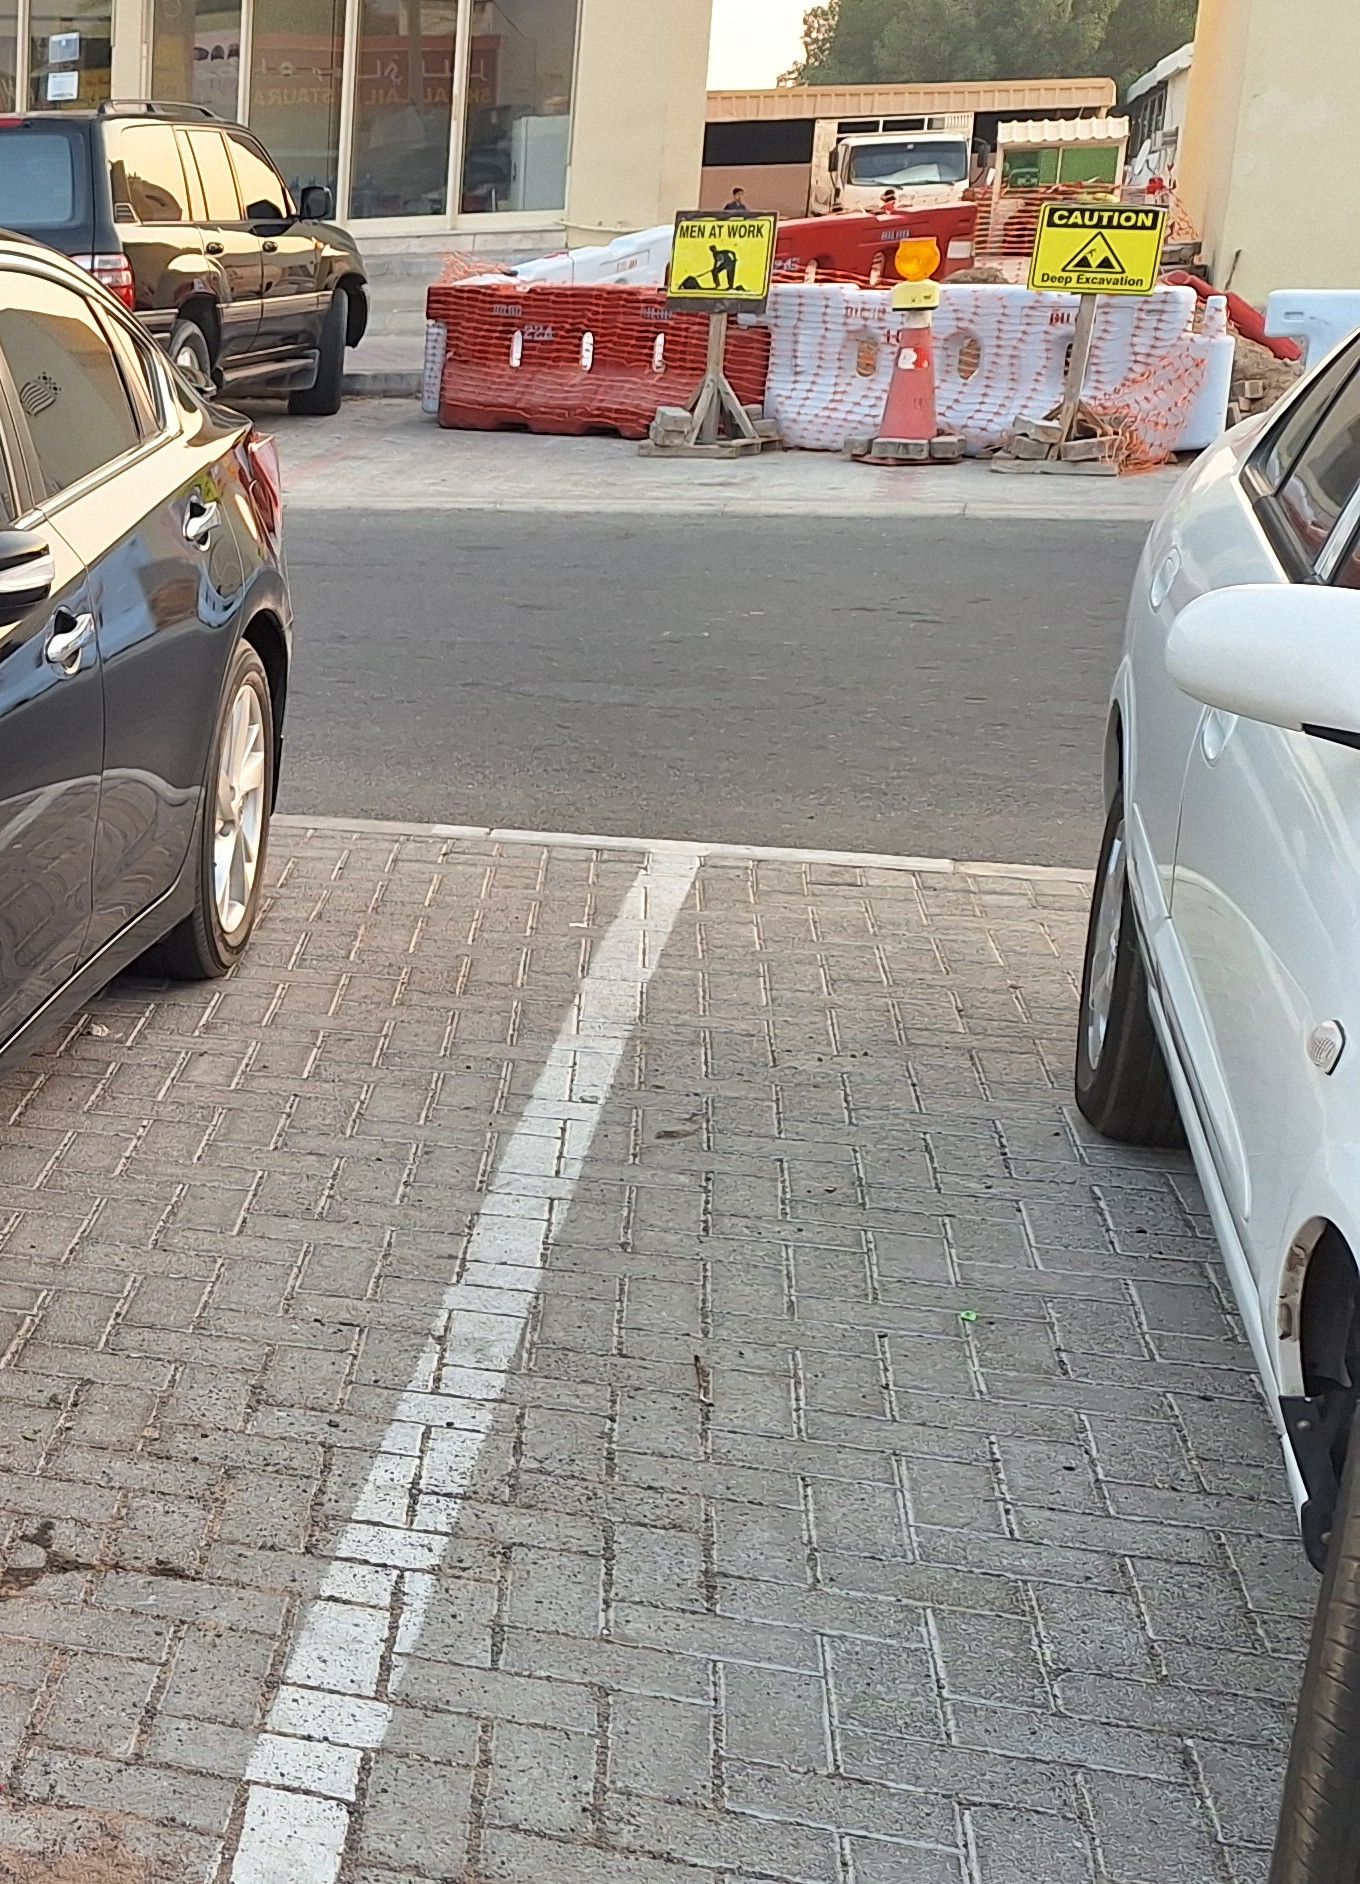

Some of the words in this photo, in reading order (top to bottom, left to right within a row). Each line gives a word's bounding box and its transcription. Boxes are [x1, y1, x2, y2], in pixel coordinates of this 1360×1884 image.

[1053, 210, 1154, 227] CAUTION
[679, 224, 706, 239] MEN
[708, 224, 724, 239] AT
[727, 223, 765, 239] WORK
[1041, 272, 1072, 286] Deep
[1076, 273, 1144, 287] Excavation
